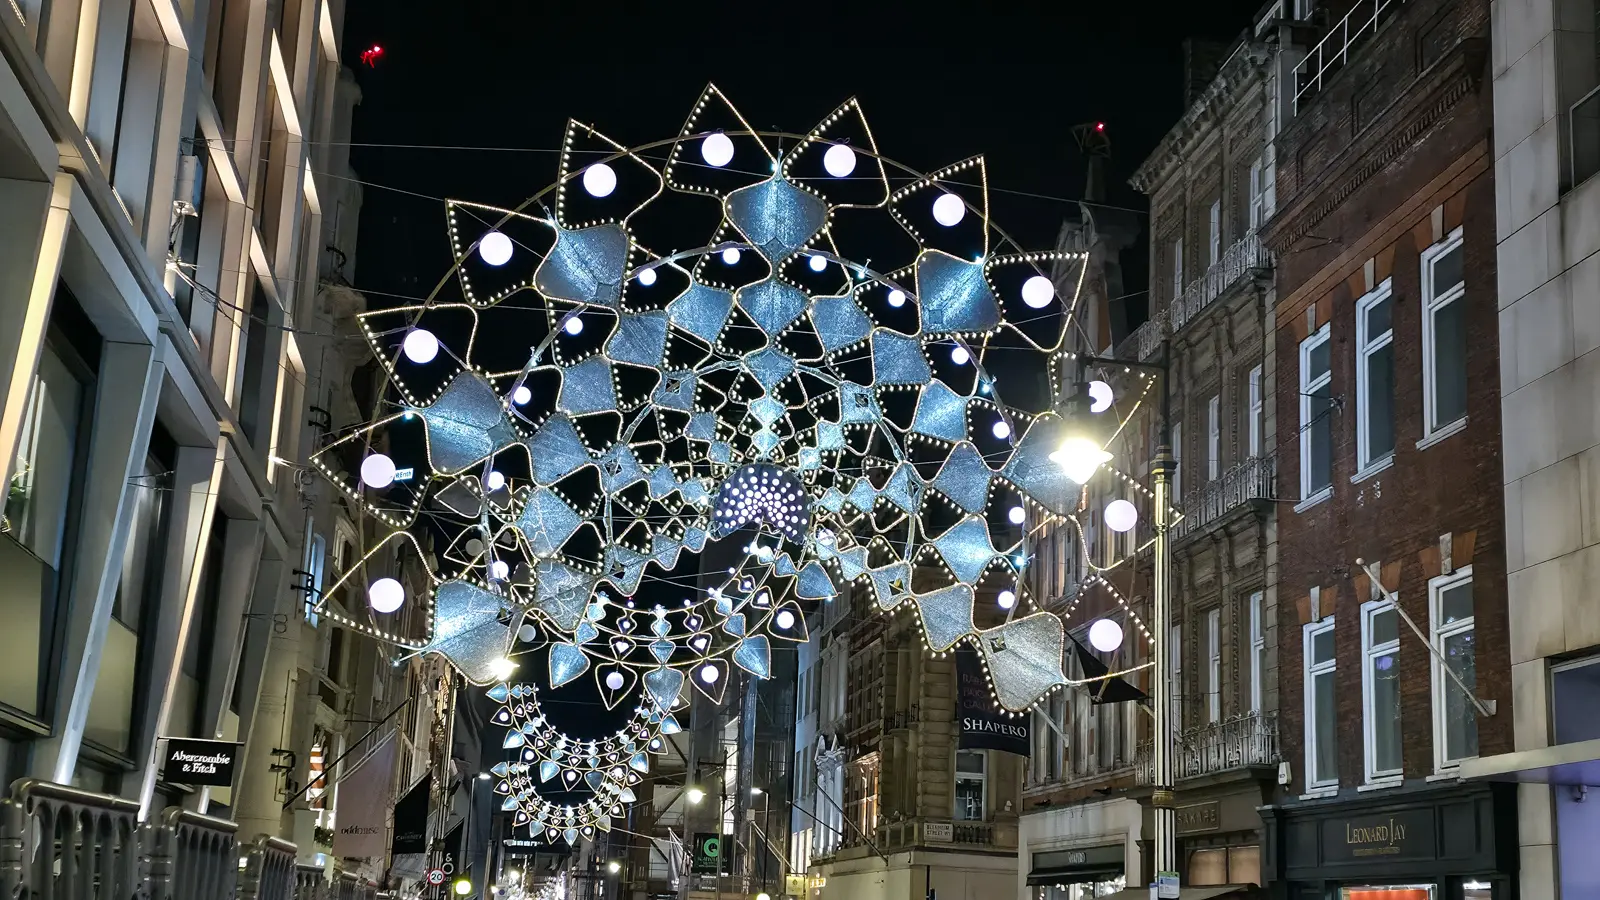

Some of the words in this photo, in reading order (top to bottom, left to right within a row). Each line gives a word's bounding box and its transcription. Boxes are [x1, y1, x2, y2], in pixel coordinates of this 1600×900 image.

[963, 717, 1027, 738] SHAPERO
[171, 750, 231, 765] Abercrombie
[182, 763, 191, 772] &
[191, 762, 217, 774] Fitch
[1346, 823, 1389, 844] LEONARD
[1389, 818, 1406, 846] JAY
[431, 873, 442, 881] 20
